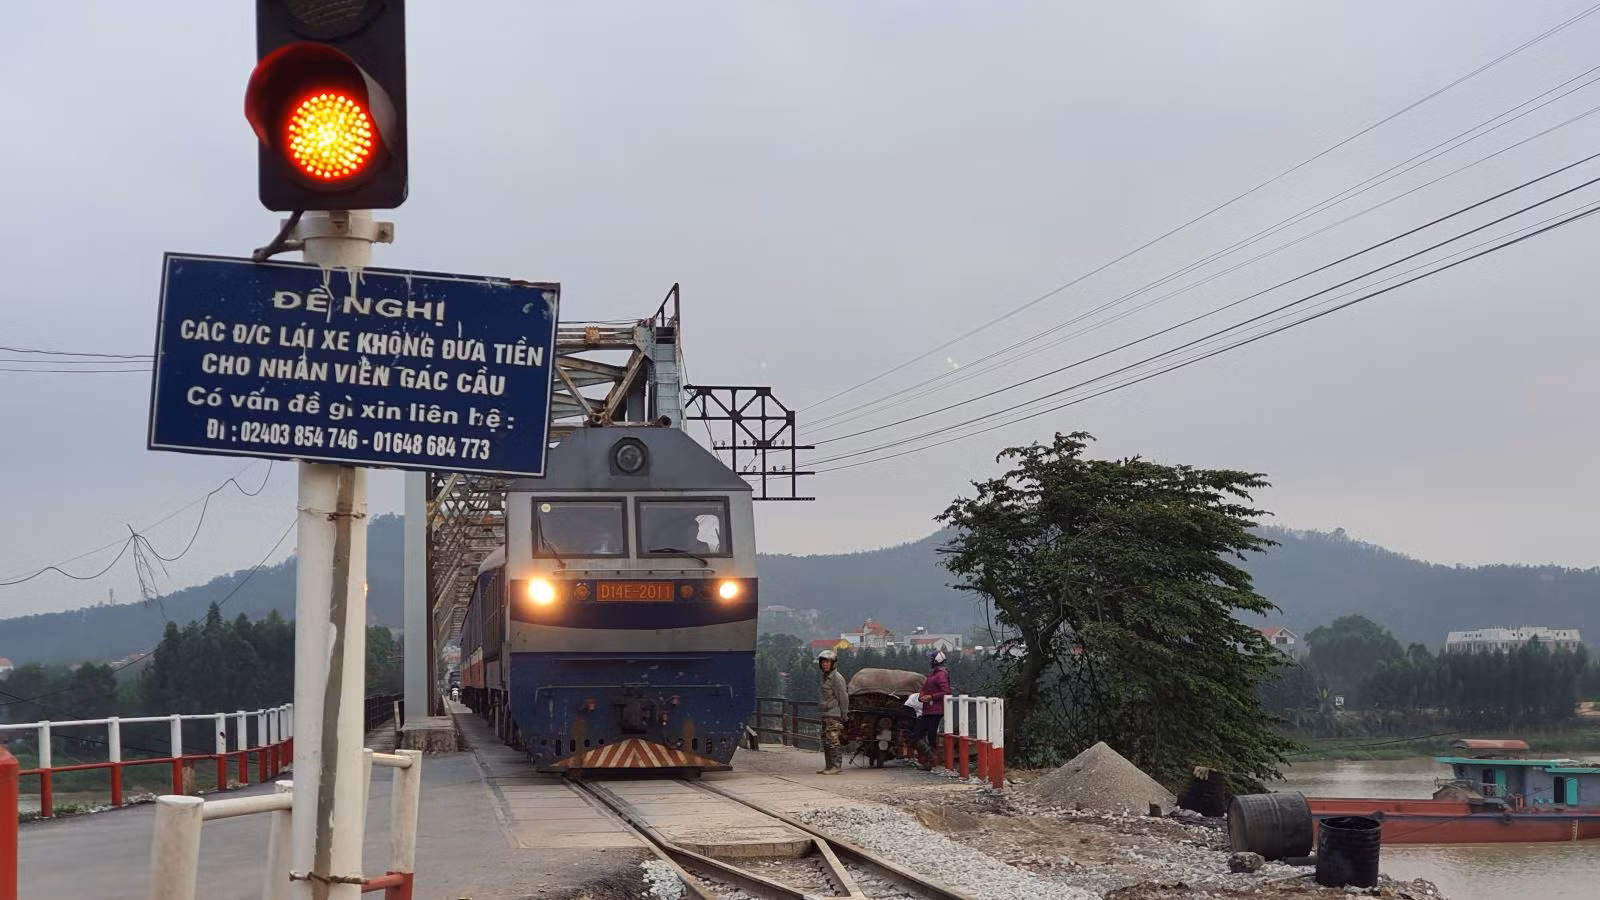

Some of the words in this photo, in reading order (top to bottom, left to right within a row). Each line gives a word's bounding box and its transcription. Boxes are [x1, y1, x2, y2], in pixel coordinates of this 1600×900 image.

[343, 296, 445, 327] NGHỊ
[181, 315, 226, 342] CÁC
[233, 323, 271, 345] Đ/C
[279, 322, 314, 348] LÁI
[321, 330, 350, 351] XE
[357, 331, 434, 358] KHÔNG
[493, 336, 543, 367] TIỀN
[202, 353, 250, 376] CHO
[258, 355, 328, 381] NHÂN
[400, 364, 448, 391] GÁC
[457, 366, 506, 396] CẦU
[187, 386, 223, 407] Có
[230, 387, 279, 411] vấn
[288, 391, 320, 414] đề
[329, 395, 353, 420] gì
[360, 401, 400, 420] xin
[409, 403, 458, 424] liên
[469, 407, 500, 432] hệ
[241, 420, 289, 445] 02403
[294, 425, 324, 447] 854
[328, 427, 358, 450] 746
[373, 431, 422, 455] 01648
[426, 435, 456, 457] 684
[461, 438, 490, 460] 773
[601, 585, 670, 599] D14E-2011
